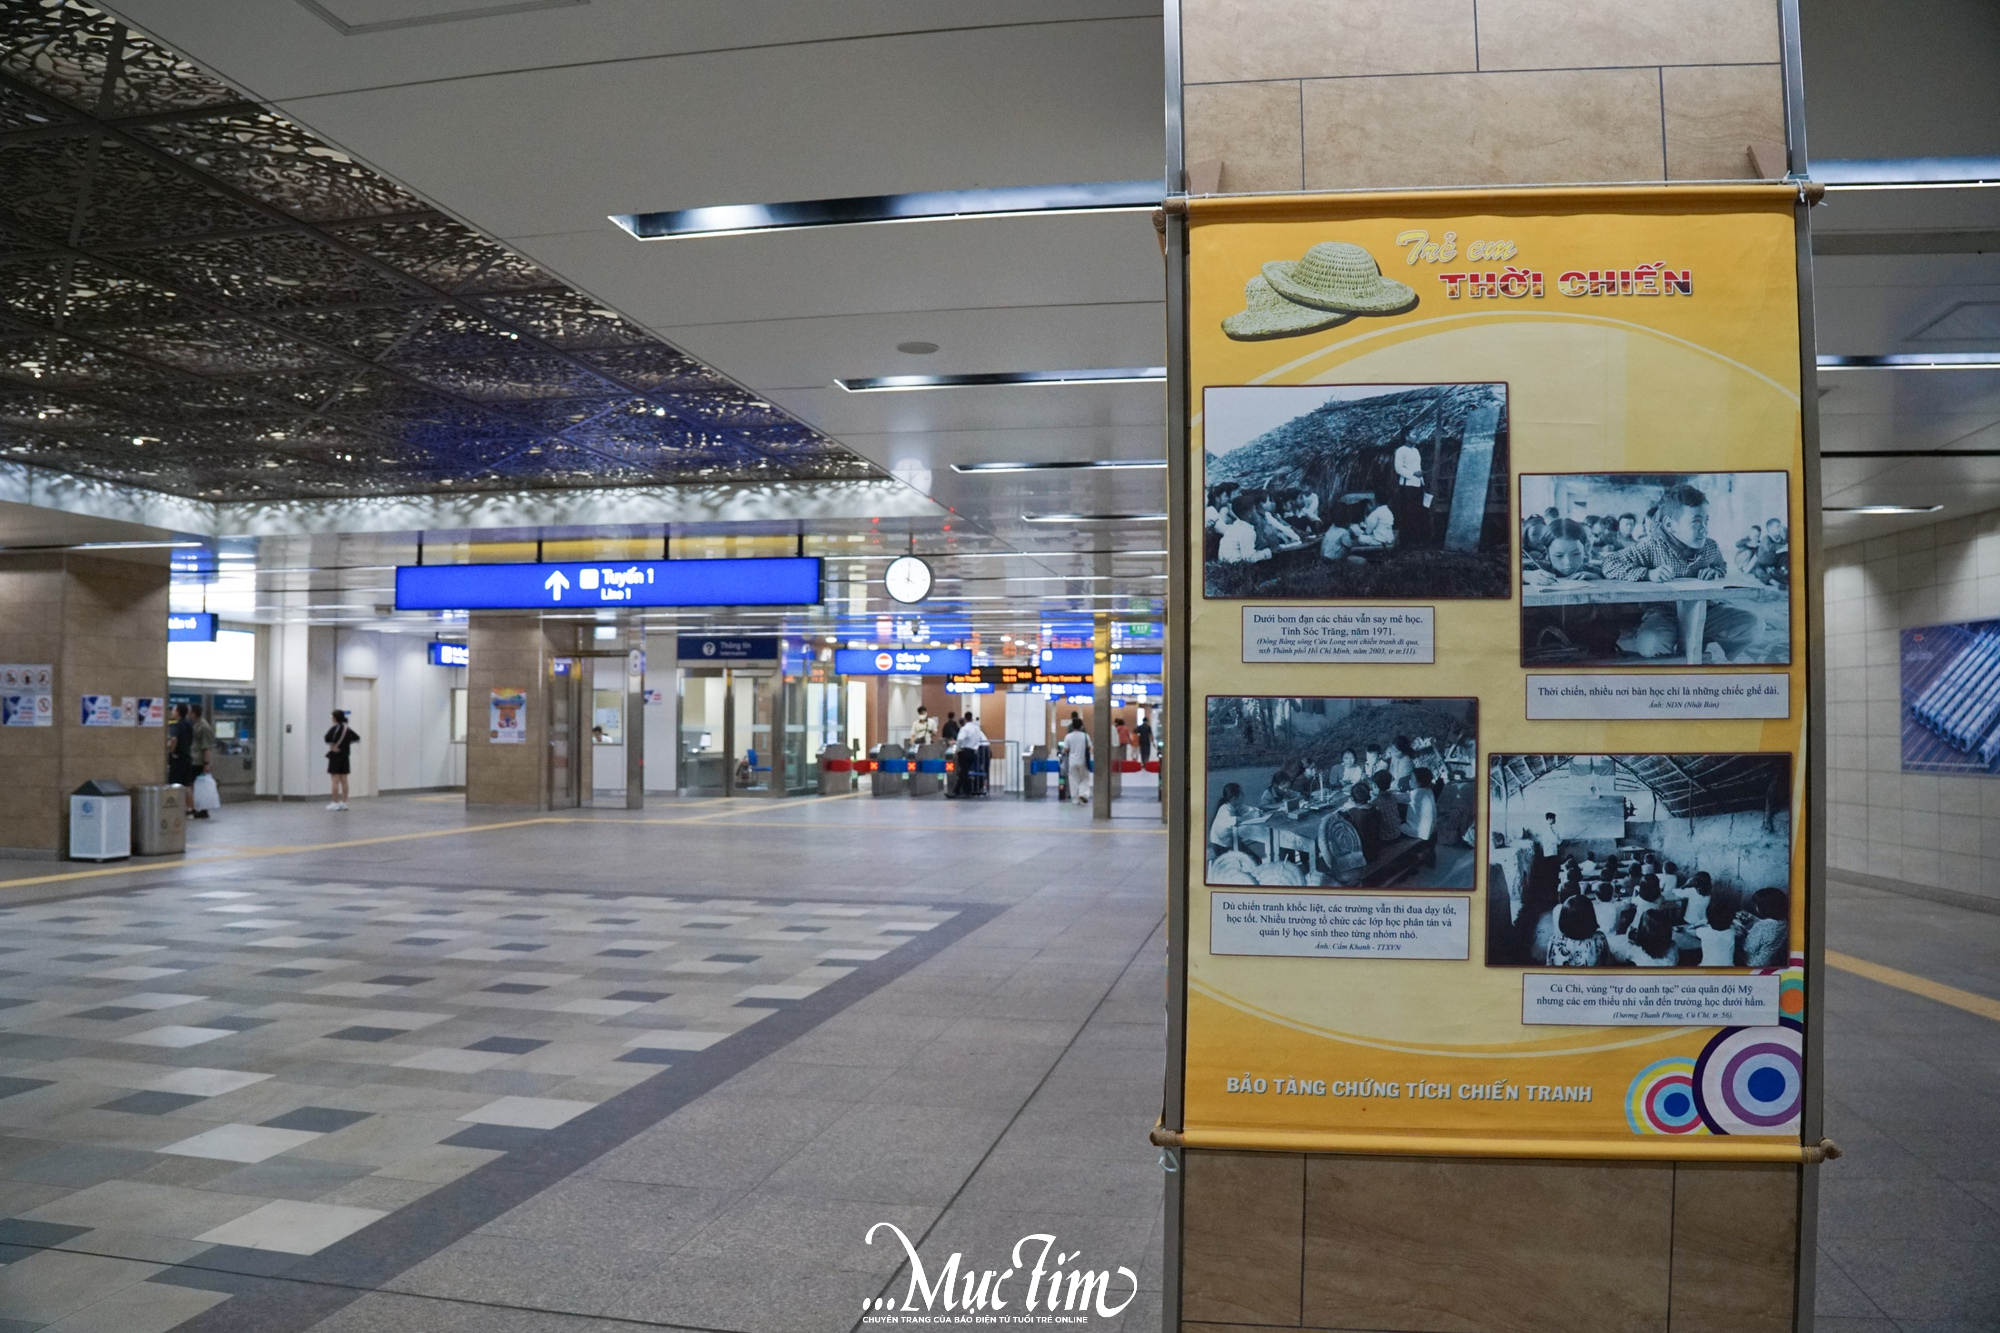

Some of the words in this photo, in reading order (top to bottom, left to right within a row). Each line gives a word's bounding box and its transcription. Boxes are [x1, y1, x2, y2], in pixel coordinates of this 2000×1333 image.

[1396, 230, 1457, 266] Trẻ
[1467, 240, 1517, 262] em
[1438, 266, 1545, 298] THỜI
[1558, 261, 1693, 297] CHIẾN
[601, 566, 644, 588] Tuyến
[647, 568, 654, 584] 1
[601, 588, 624, 600] Line
[625, 588, 631, 600] 1
[1254, 615, 1275, 623] Dưới
[1278, 615, 1296, 623] bom
[1299, 615, 1314, 625] đạn
[1316, 615, 1330, 623] các
[1333, 615, 1353, 623] cháu
[1356, 613, 1370, 623] vẫn
[1373, 617, 1387, 625] say
[1390, 615, 1403, 623] mê
[1406, 615, 1423, 625] học.
[1281, 627, 1301, 635] Tỉnh
[1303, 627, 1319, 635] Sóc
[1321, 627, 1349, 637] Trăng,
[1360, 637, 1377, 645] chiến
[1294, 646, 1306, 655] phố
[1308, 646, 1318, 654] Hồ
[1538, 688, 1558, 696] Thời
[1561, 685, 1587, 697] chiến,
[1590, 685, 1613, 696] nhiều
[1616, 688, 1629, 696] nơi
[1632, 688, 1647, 696] bàn
[1650, 687, 1665, 697] học
[1667, 687, 1680, 695] chỉ
[1683, 687, 1690, 695] là
[1693, 687, 1719, 697] những
[1722, 684, 1744, 695] chiếc
[1747, 684, 1762, 697] ghế
[1764, 687, 1780, 695] dài.
[1223, 902, 1235, 910] Dù
[1238, 900, 1260, 911] chiến
[1263, 903, 1284, 912] tranh
[1287, 901, 1307, 912] khốc
[1310, 903, 1325, 913] liệt,
[1328, 905, 1342, 913] các
[1345, 905, 1373, 915] trường
[1376, 903, 1391, 914] vẫn
[1394, 905, 1404, 914] thi
[1407, 906, 1422, 914] đua
[1425, 906, 1440, 916] dạy
[1443, 904, 1456, 915] tốt,
[1227, 914, 1242, 924] học
[1244, 913, 1257, 923] tốt.
[1260, 913, 1286, 924] Nhiều
[1289, 916, 1316, 926] trường
[1319, 914, 1327, 925] tổ
[1330, 917, 1350, 925] chức
[1353, 917, 1366, 926] các
[1370, 918, 1383, 927] lớp
[1386, 918, 1400, 927] học
[1404, 918, 1423, 928] phân
[1427, 919, 1439, 927] tán
[1259, 928, 1279, 937] quản
[1283, 928, 1290, 938] lý
[1293, 928, 1308, 938] học
[1311, 929, 1328, 937] sinh
[1331, 929, 1349, 937] theo
[1352, 931, 1370, 939] từng
[1400, 931, 1418, 939] nhỏ.
[1551, 984, 1563, 993] Củ
[1566, 985, 1584, 994] Chi,
[1587, 987, 1607, 995] vùng
[1626, 986, 1636, 994] do
[1639, 986, 1660, 994] oanh
[1699, 985, 1719, 995] quân
[1722, 985, 1735, 995] đội
[1738, 985, 1753, 996] Mỹ
[1537, 997, 1564, 1007] nhưng
[1567, 997, 1580, 1005] các
[1599, 996, 1620, 1006] thiếu
[1622, 998, 1636, 1006] nhi
[1639, 996, 1653, 1006] vẫn
[1656, 996, 1671, 1006] đến
[1674, 998, 1702, 1008] trường
[1705, 998, 1720, 1008] học
[1723, 998, 1742, 1006] dưới
[1745, 996, 1766, 1006] hầm.
[1613, 1012, 1638, 1020] (Dương
[1227, 1072, 1267, 1094] BẢO
[1273, 1075, 1326, 1096] TÀNG
[1332, 1078, 1400, 1098] CHỨNG
[1406, 1080, 1451, 1099] TÍCH
[1458, 1079, 1519, 1101] CHIẾN
[1526, 1085, 1592, 1102] TRANH
